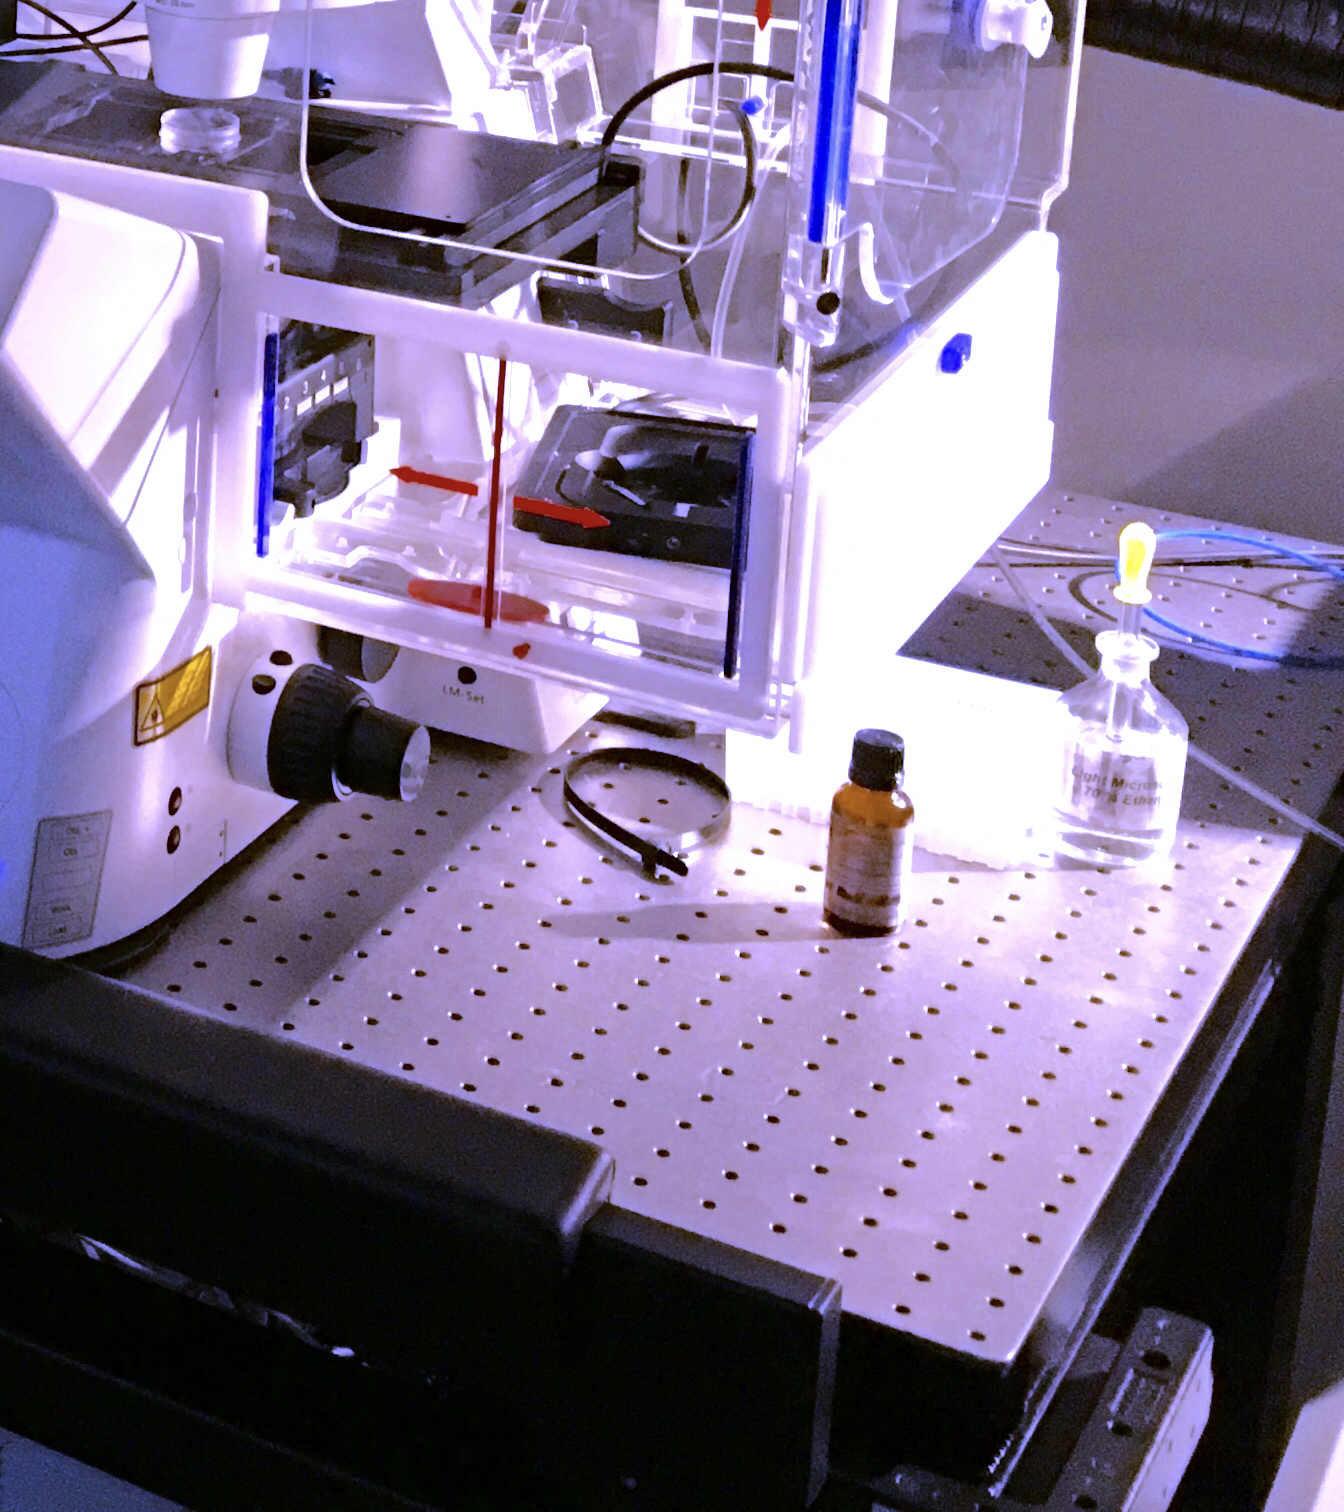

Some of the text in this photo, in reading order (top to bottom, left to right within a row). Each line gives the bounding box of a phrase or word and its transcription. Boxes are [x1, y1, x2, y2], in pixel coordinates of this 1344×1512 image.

[283, 396, 291, 411] 2
[302, 381, 309, 396] 3
[320, 370, 327, 383] 4
